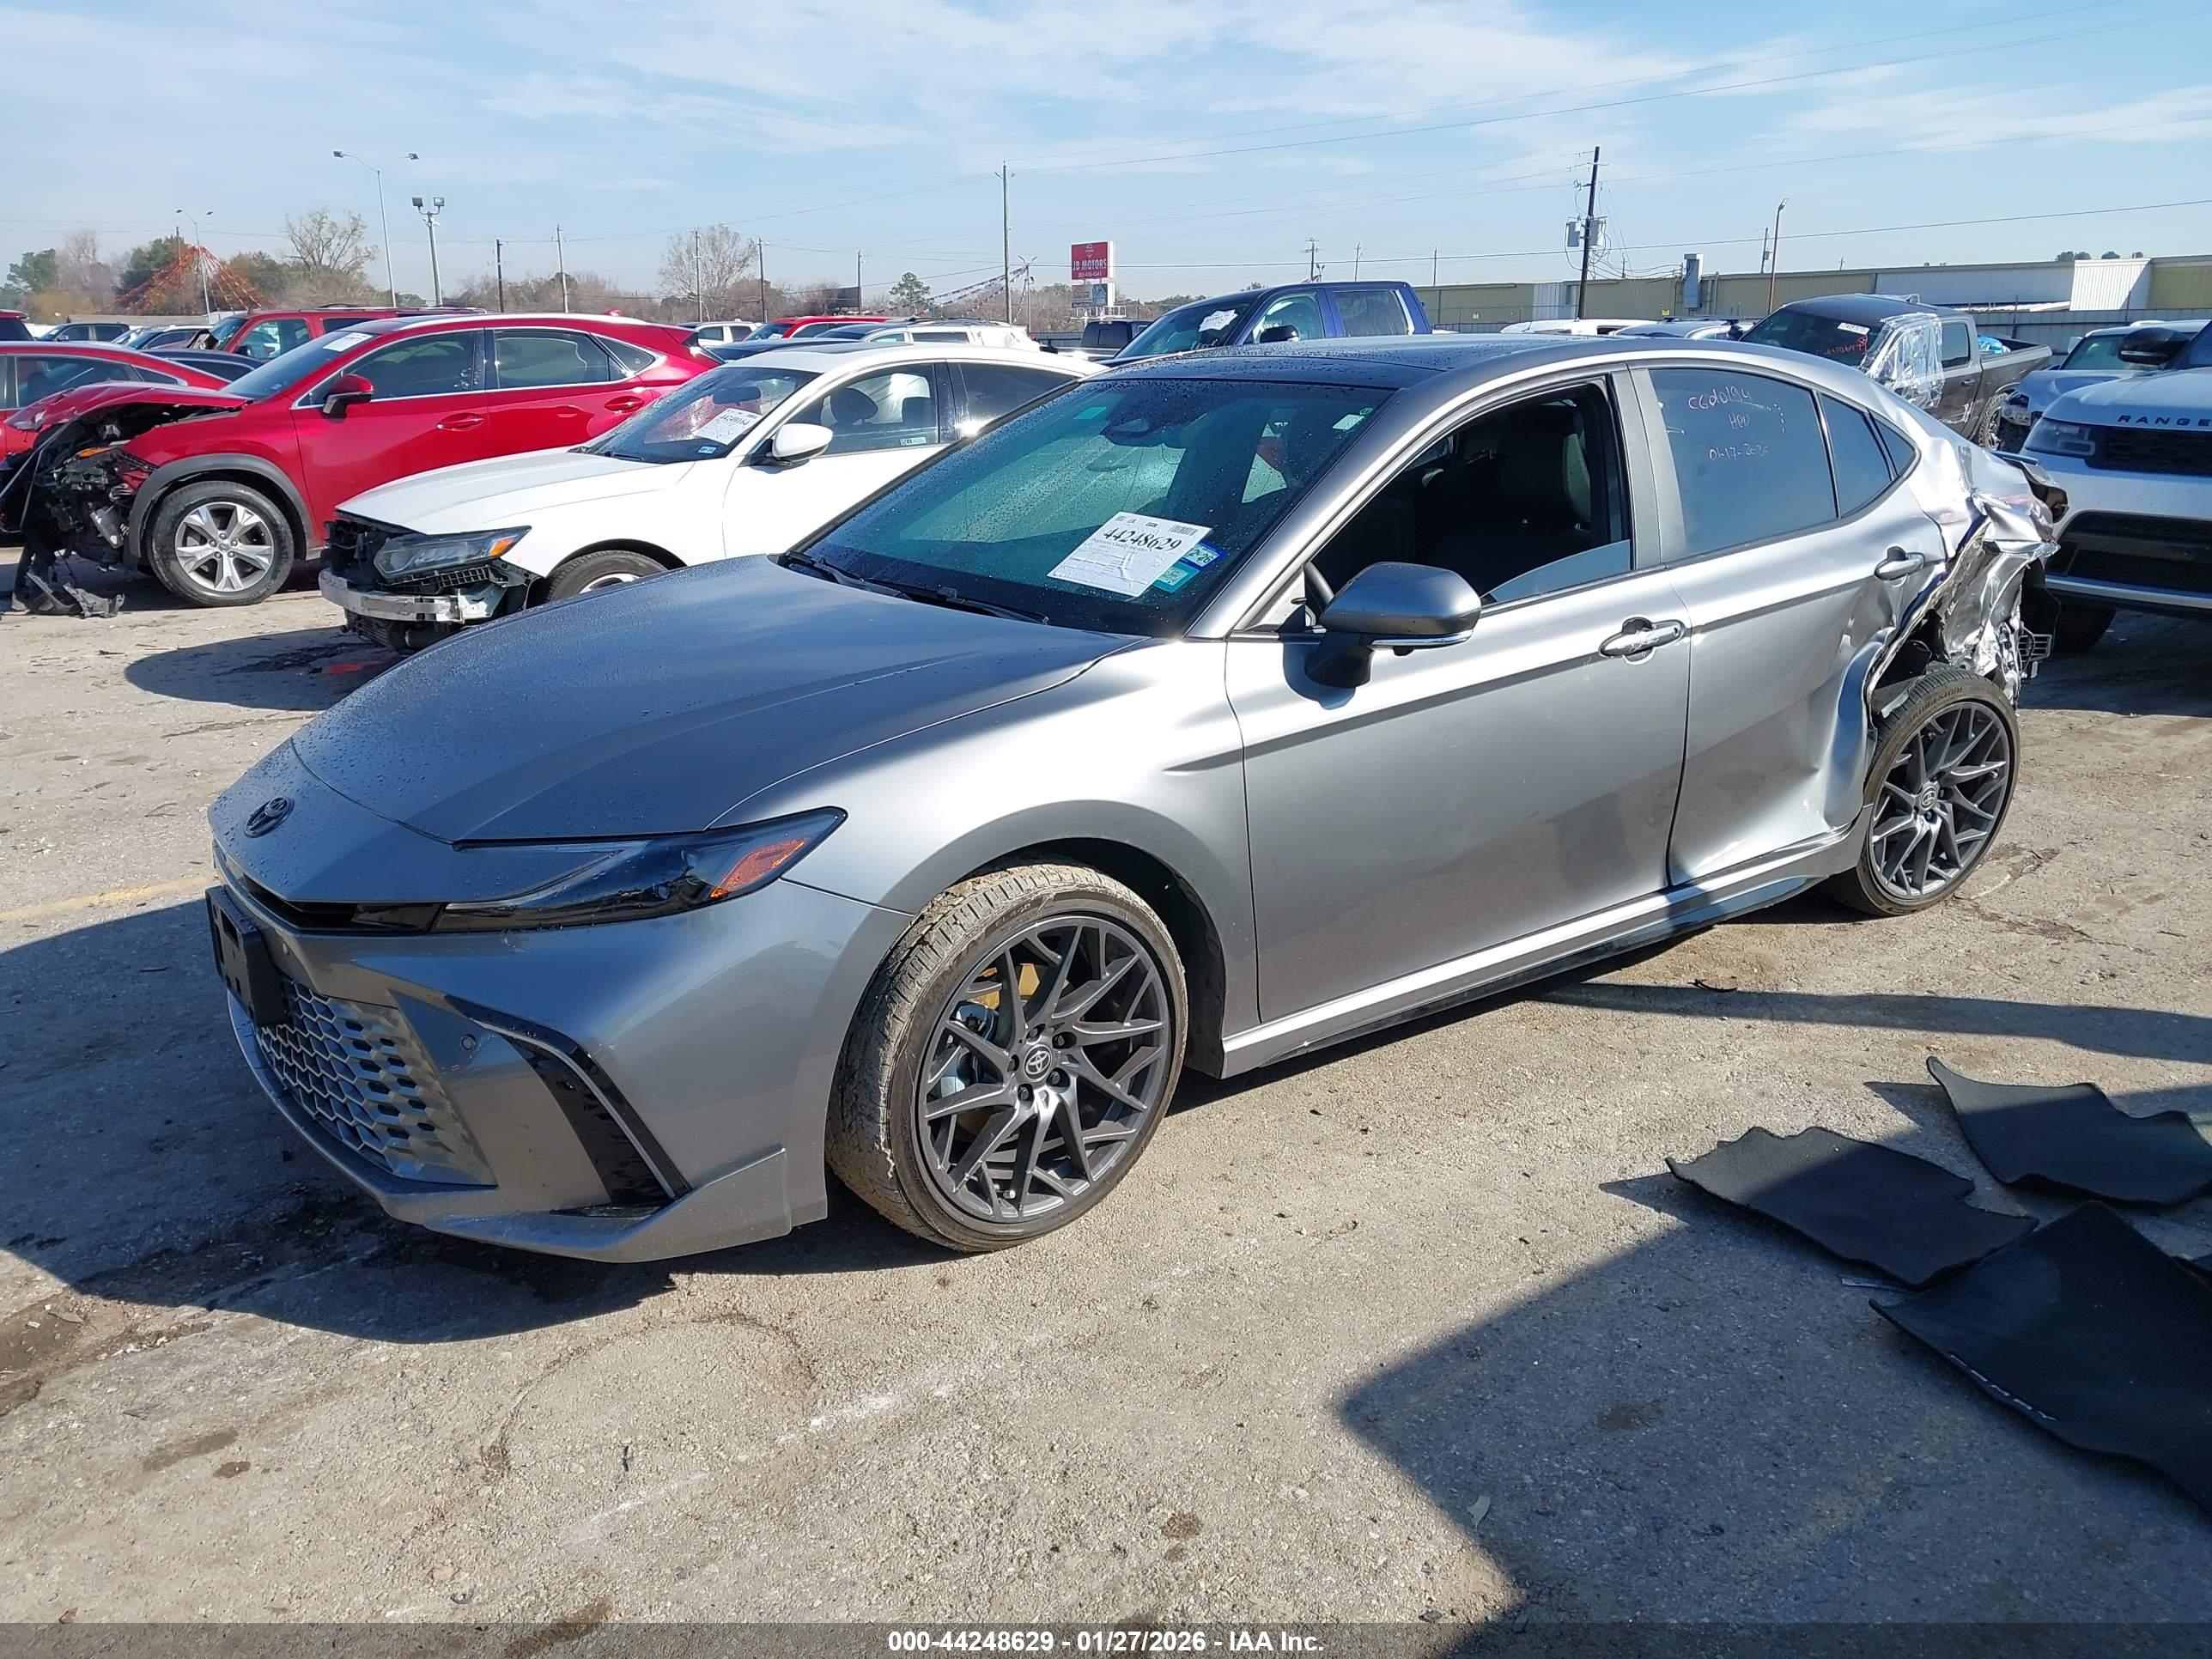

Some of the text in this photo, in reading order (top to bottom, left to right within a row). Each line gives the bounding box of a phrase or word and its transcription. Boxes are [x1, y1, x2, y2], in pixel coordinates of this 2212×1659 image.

[1081, 258, 1107, 270] MOTORS
[2118, 415, 2212, 427] RANGE
[1103, 528, 1182, 551] 44248629
